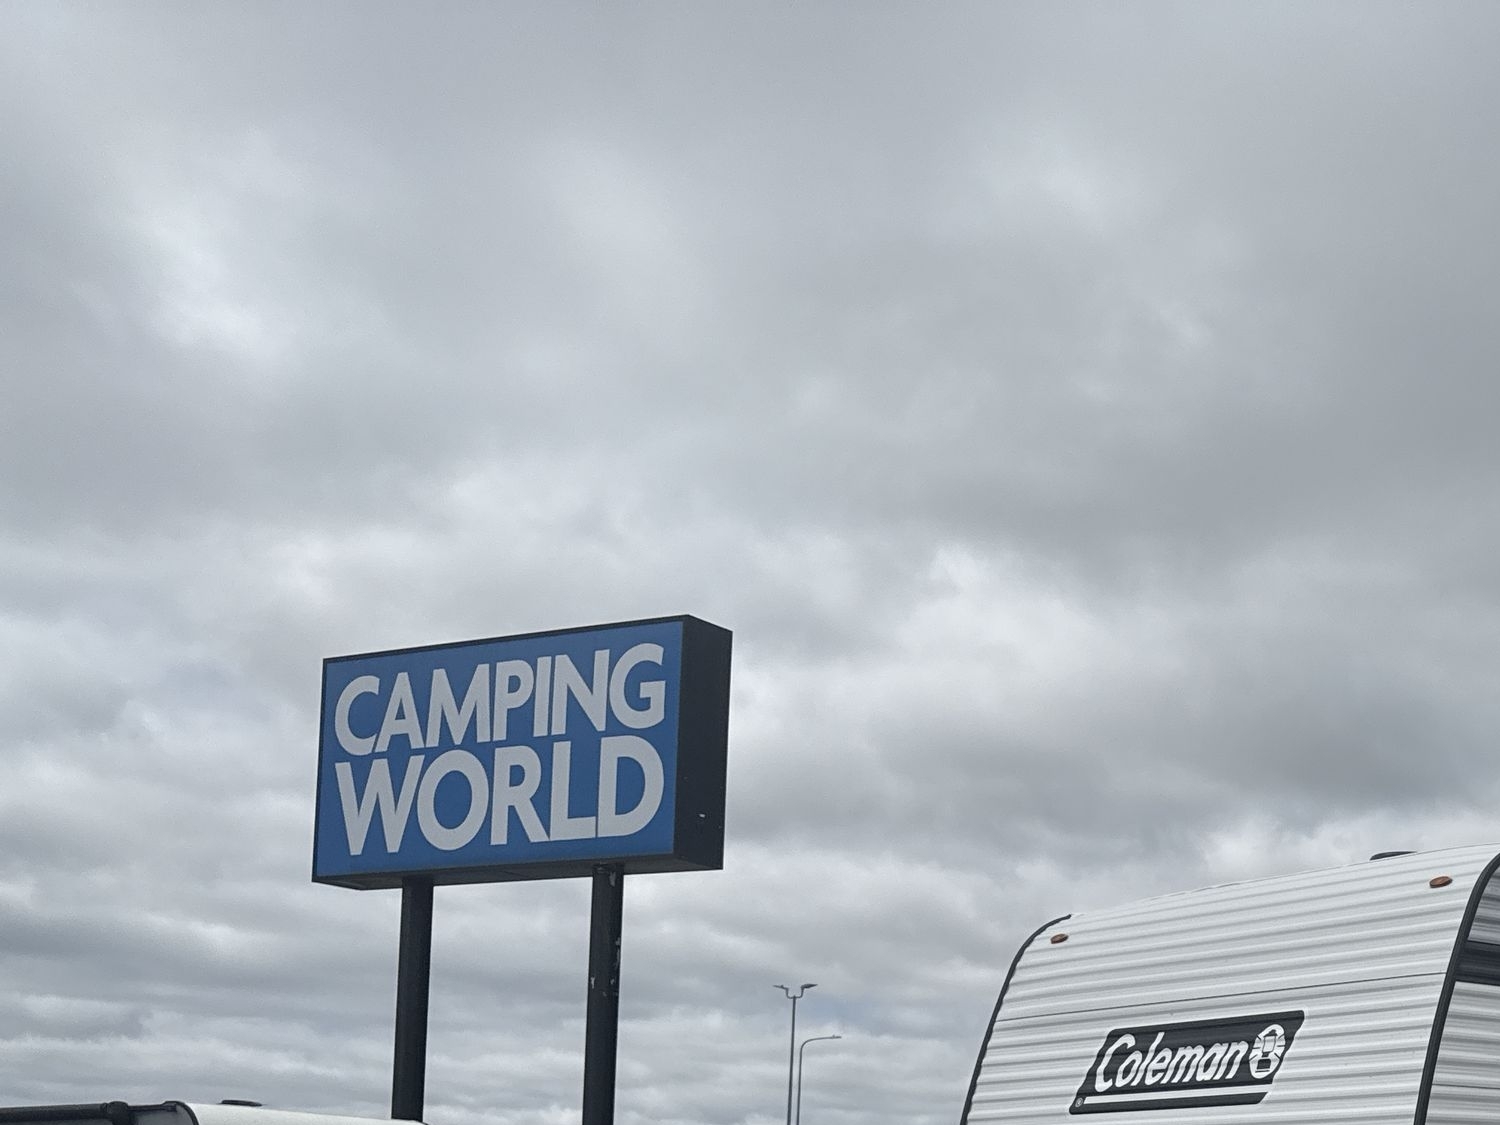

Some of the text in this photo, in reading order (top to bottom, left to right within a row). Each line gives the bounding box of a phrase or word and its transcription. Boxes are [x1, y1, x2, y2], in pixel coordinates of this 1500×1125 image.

[334, 643, 666, 756] CAMPING
[335, 735, 665, 855] WORLD
[1095, 1032, 1249, 1092] Coleman
